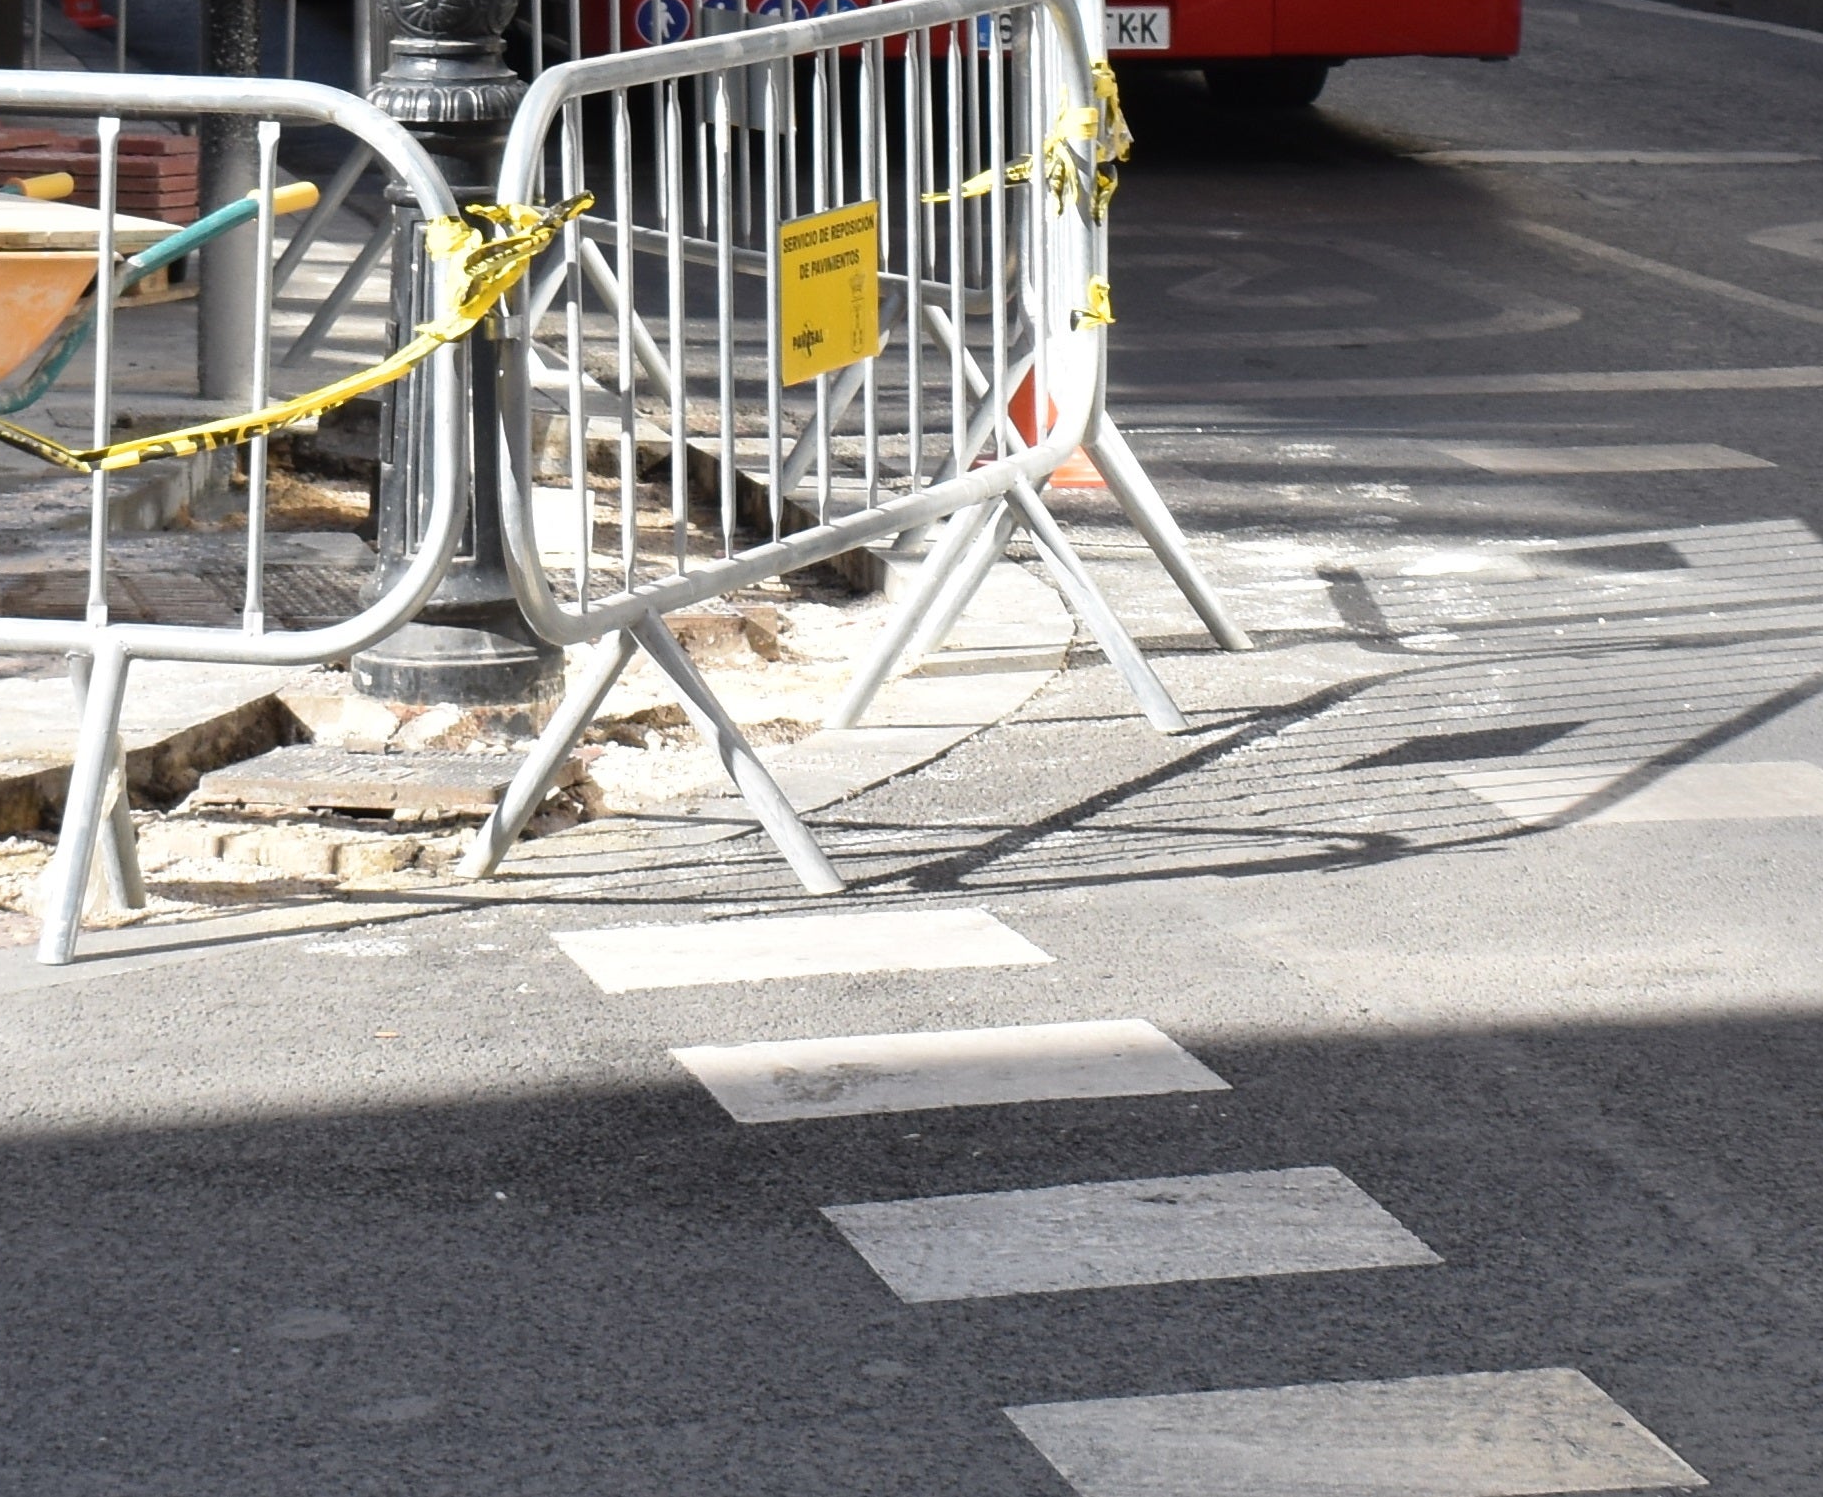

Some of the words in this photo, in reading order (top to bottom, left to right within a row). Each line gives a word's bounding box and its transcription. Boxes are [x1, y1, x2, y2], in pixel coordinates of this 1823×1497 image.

[783, 229, 818, 254] SERVICIO
[820, 225, 829, 245] DE
[799, 264, 811, 281] DE
[811, 248, 861, 278] PAVIMIENTOS
